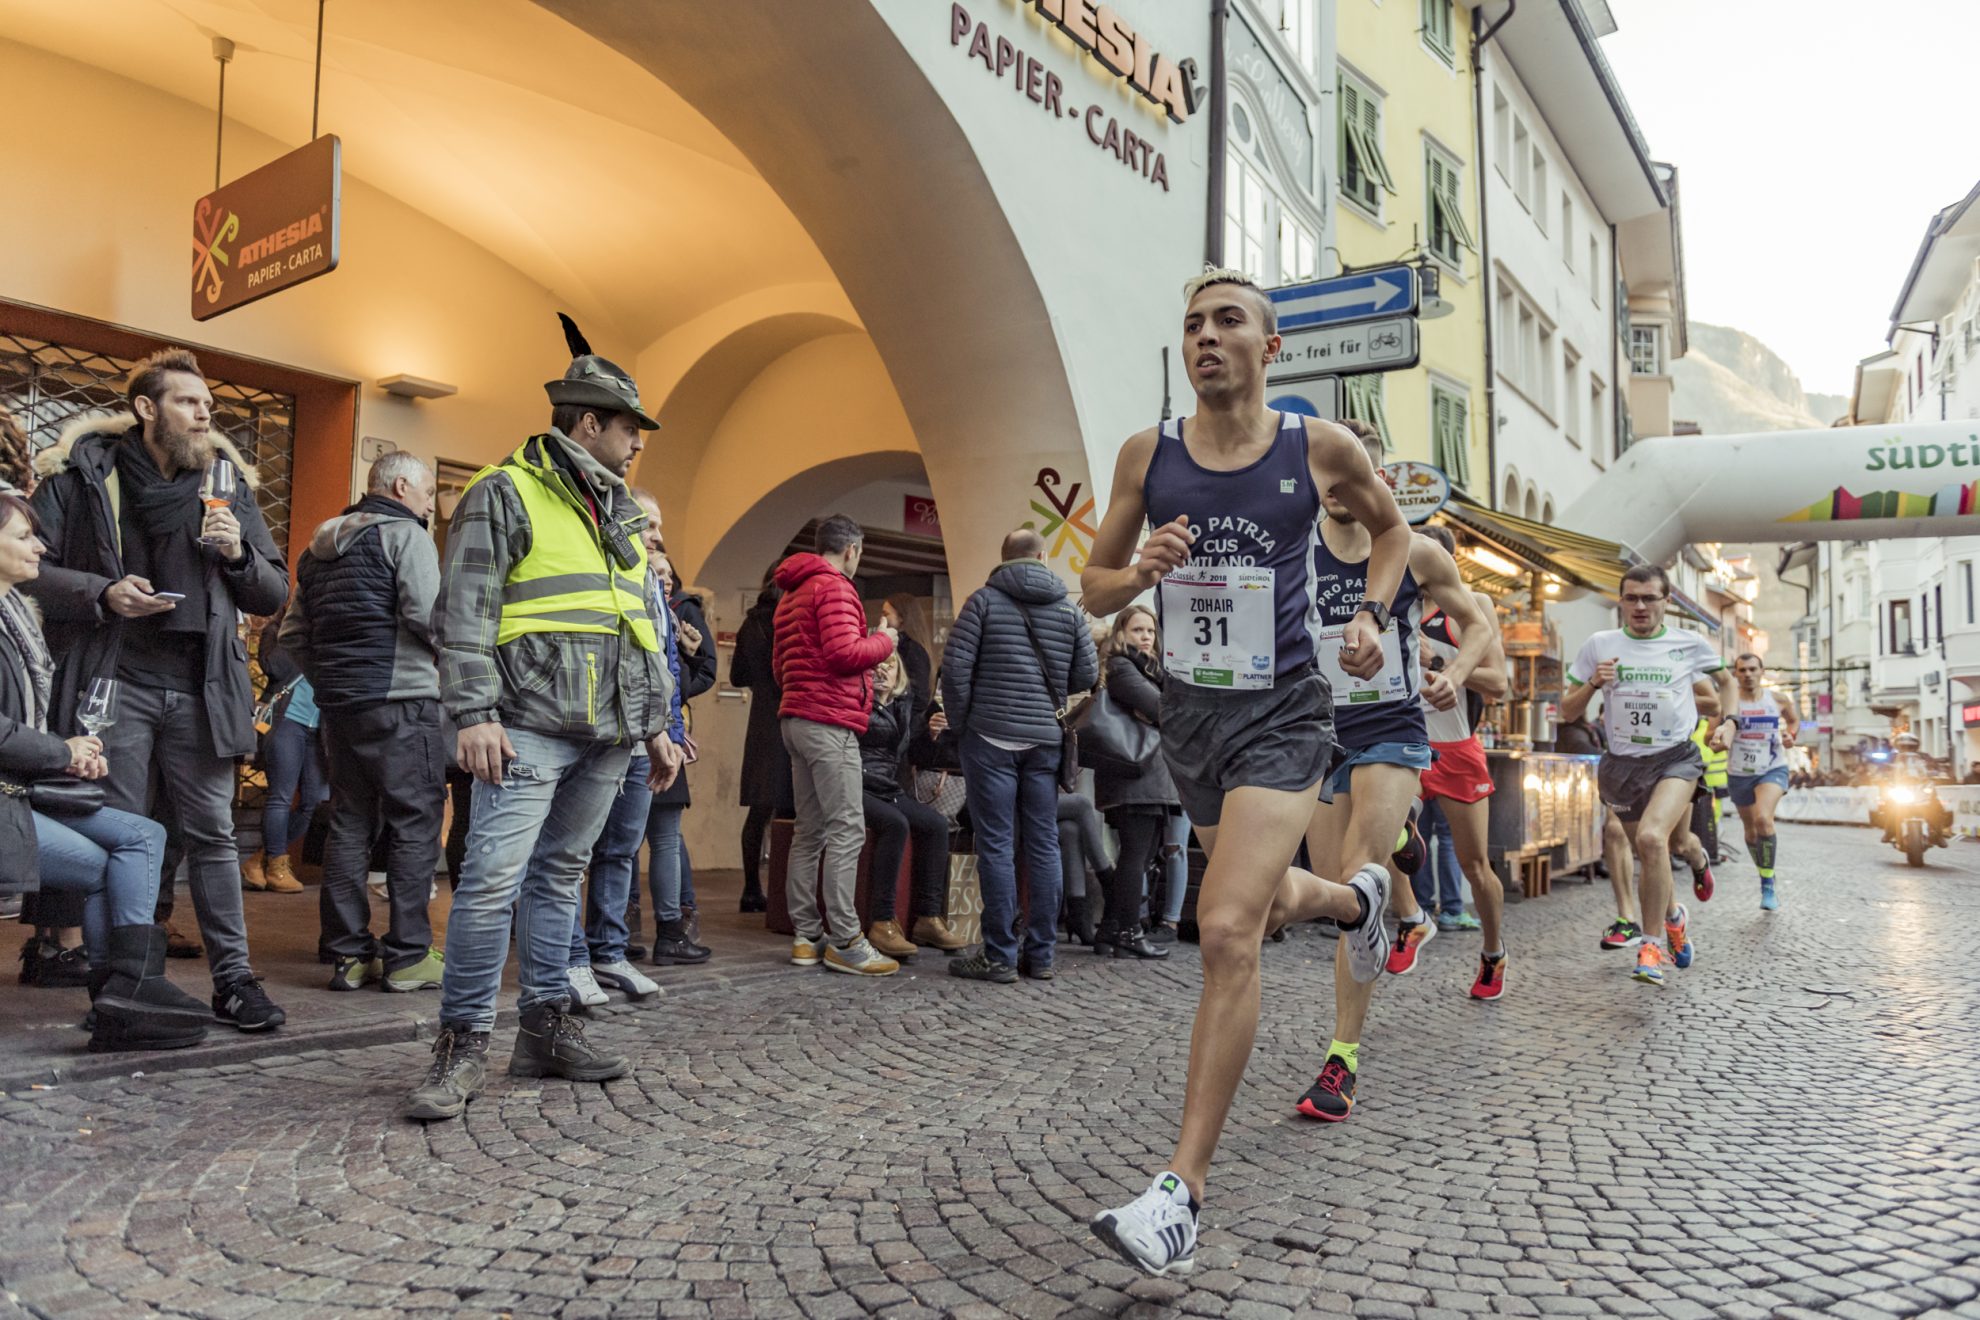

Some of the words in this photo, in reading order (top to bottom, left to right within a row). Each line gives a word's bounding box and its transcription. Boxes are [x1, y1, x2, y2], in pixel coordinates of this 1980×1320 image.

[951, 2, 1063, 118] PAPIER
[1086, 105, 1170, 192] CARTA
[237, 212, 323, 269] ATHESIA
[248, 261, 281, 288] PAPIER
[288, 243, 323, 271] CARTA
[1306, 343, 1331, 359] frei
[1340, 339, 1361, 354] für
[1203, 538, 1239, 554] CUS
[1208, 516, 1277, 554] PATRIA
[1186, 555, 1256, 568] MILANO
[1210, 574, 1228, 582] 2018
[1190, 598, 1234, 613] ZOHAIR
[1317, 583, 1342, 607] PRO
[1193, 616, 1229, 647] 31
[1630, 711, 1652, 726] 34
